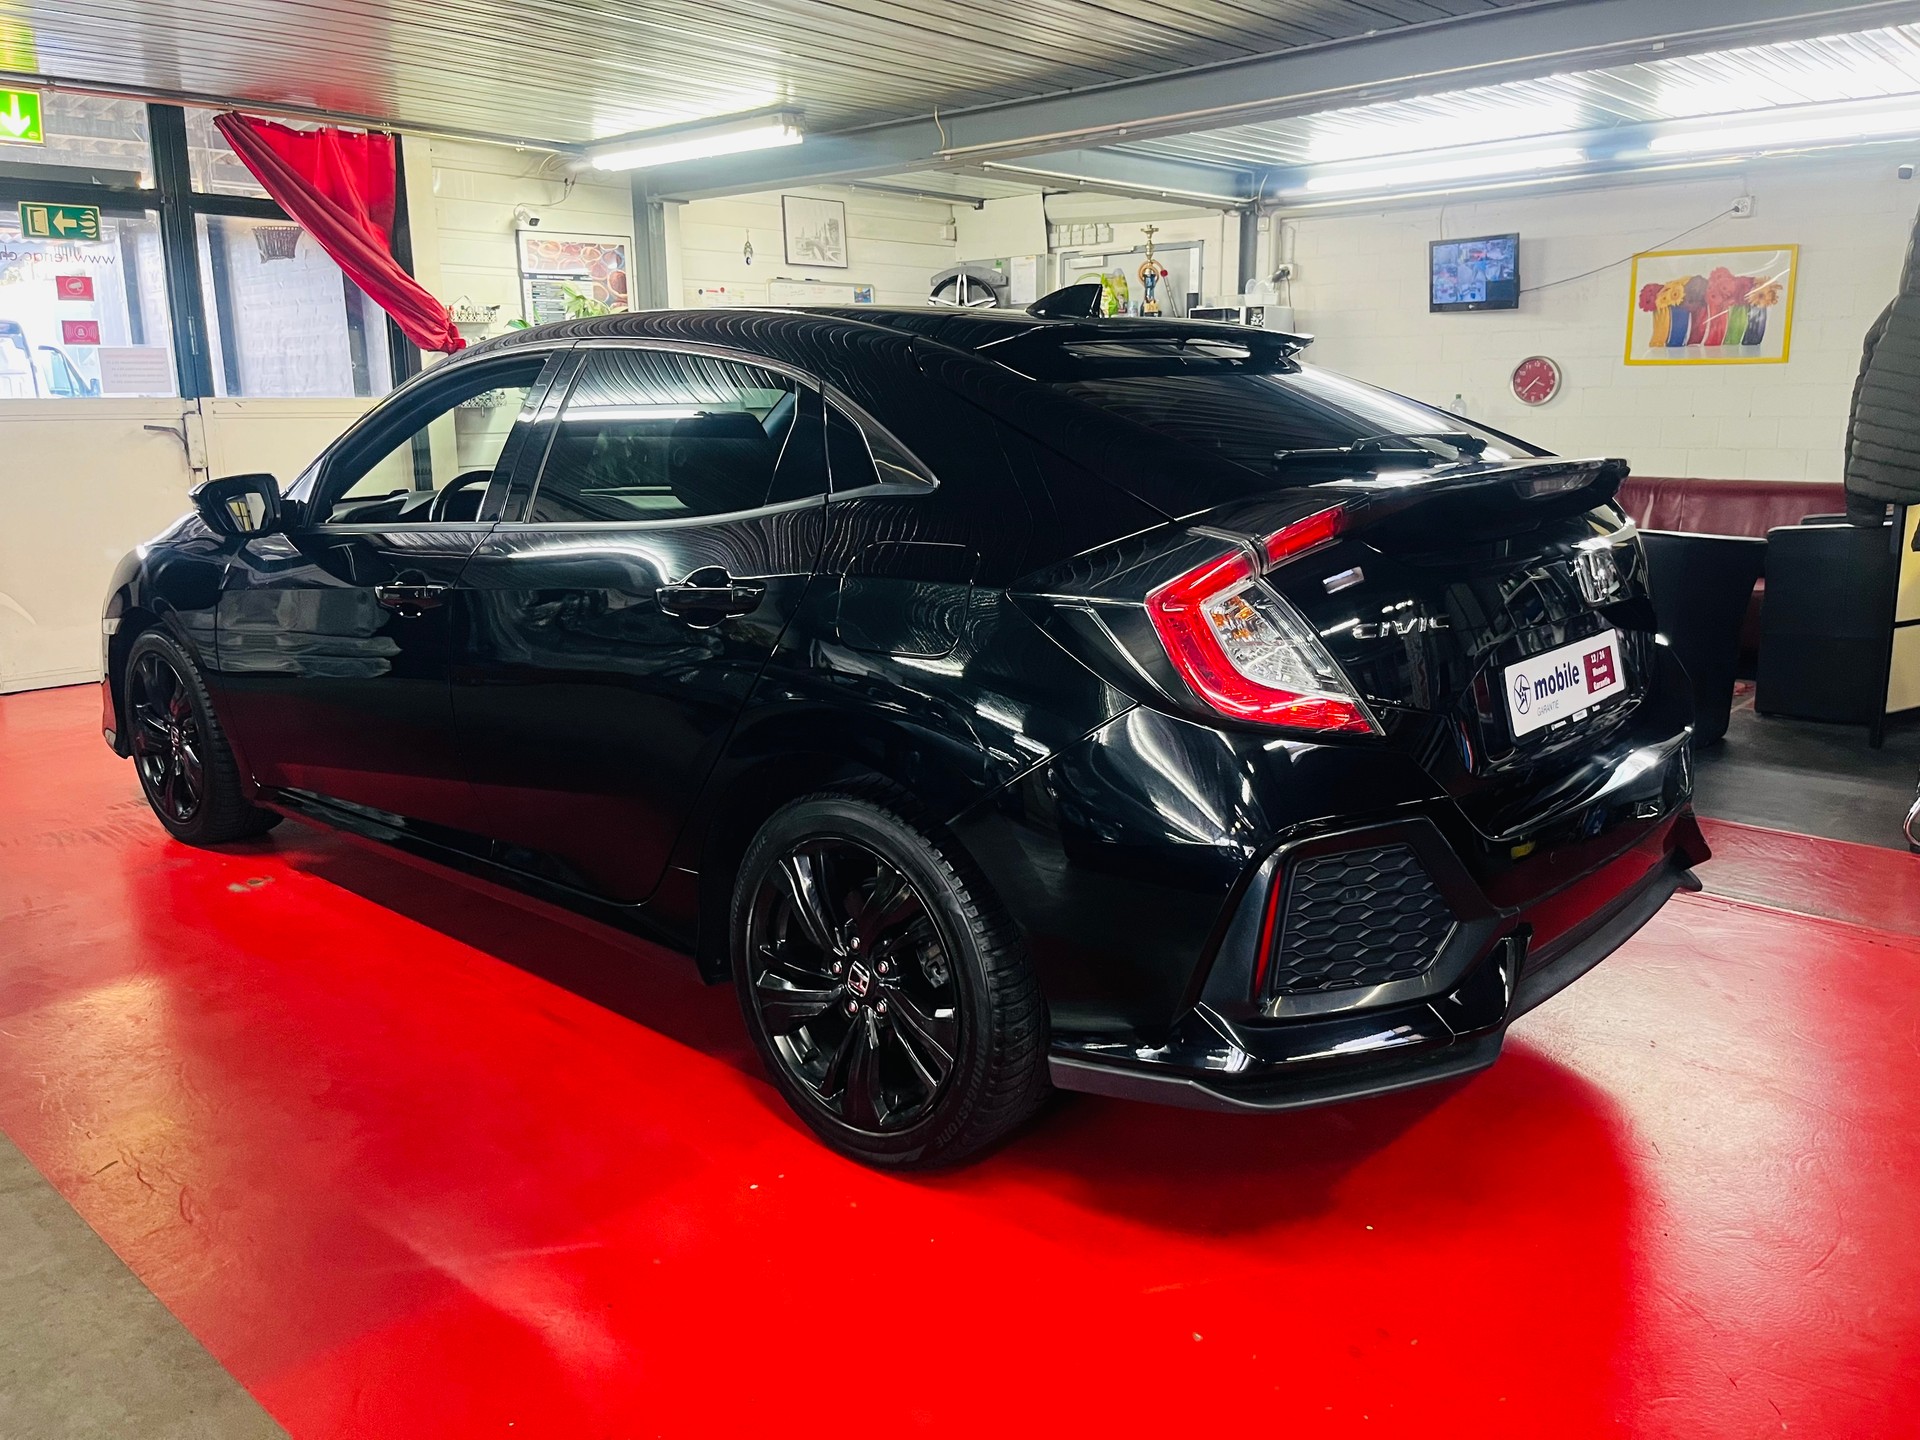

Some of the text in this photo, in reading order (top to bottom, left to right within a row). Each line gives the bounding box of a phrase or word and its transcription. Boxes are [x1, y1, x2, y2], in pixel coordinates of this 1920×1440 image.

[1351, 614, 1450, 640] CIVIC
[1533, 661, 1580, 701] mobile
[1537, 699, 1560, 717] GARANTIE
